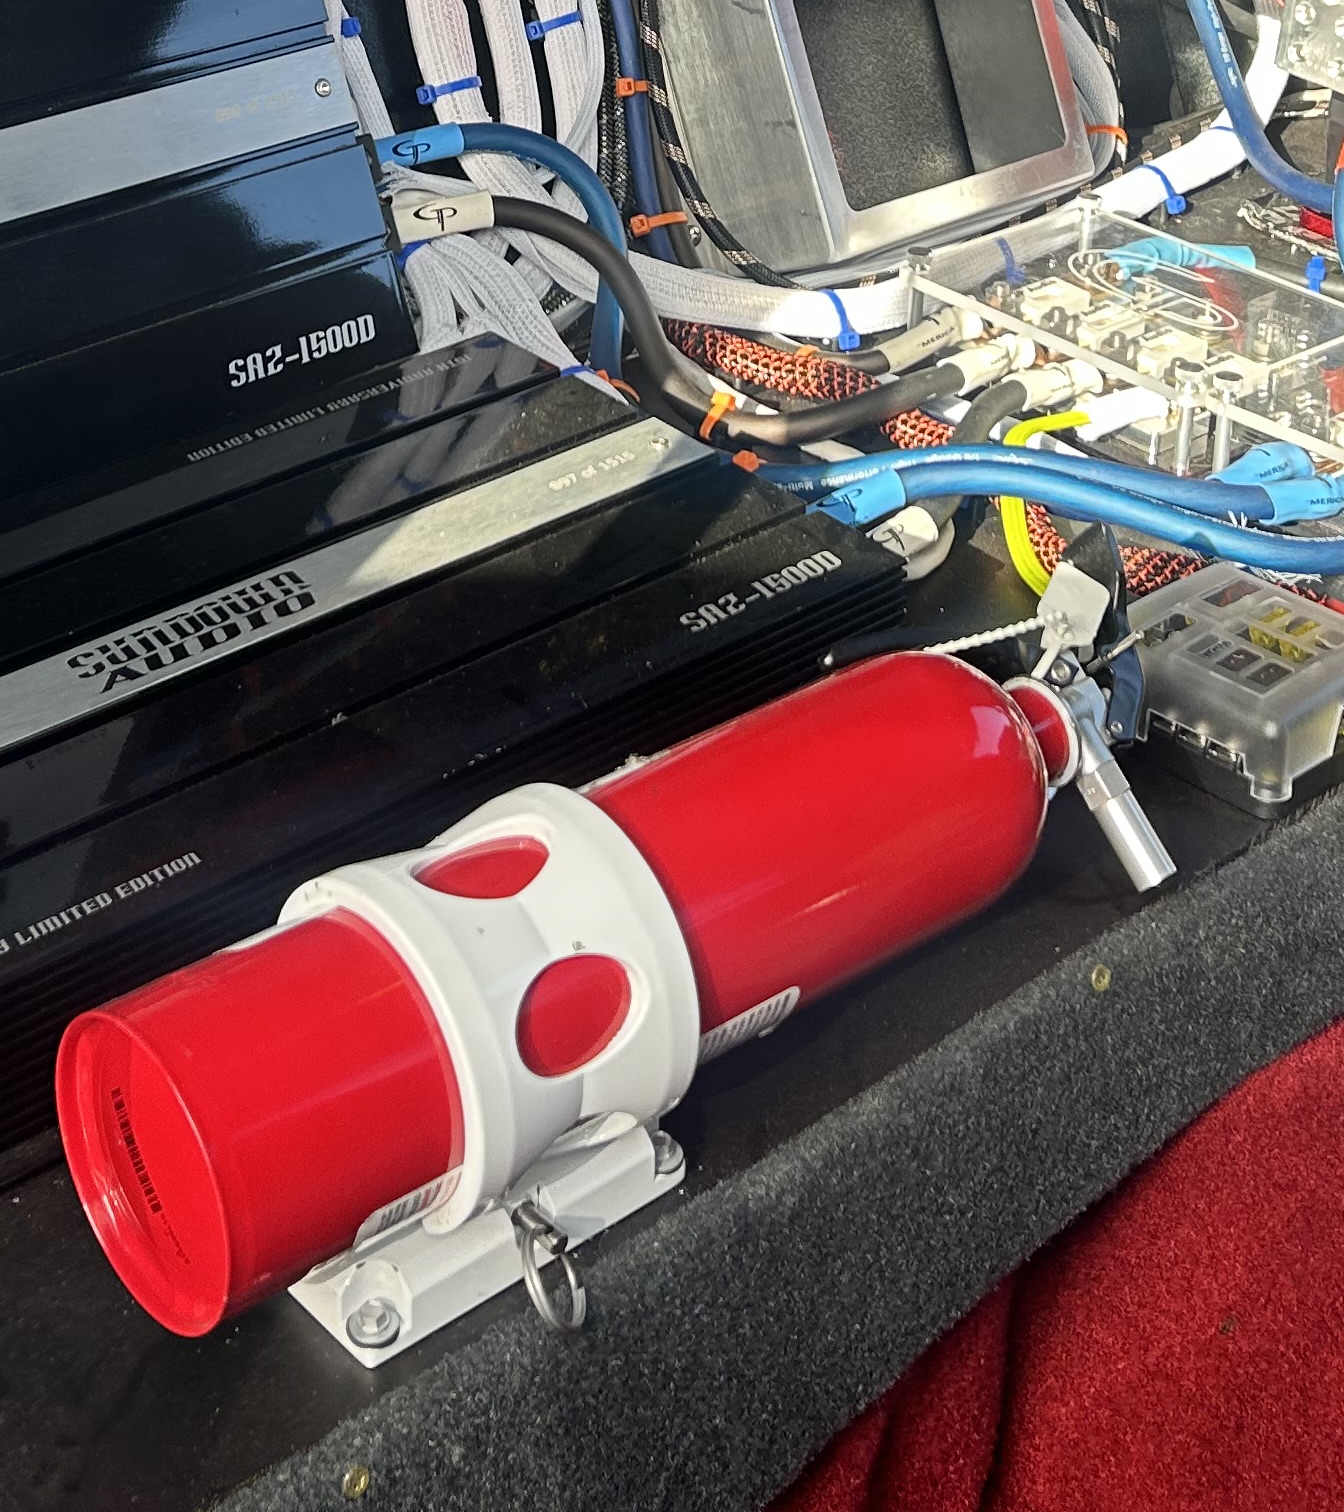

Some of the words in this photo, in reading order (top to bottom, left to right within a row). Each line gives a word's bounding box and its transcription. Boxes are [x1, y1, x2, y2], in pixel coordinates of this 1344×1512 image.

[255, 405, 326, 438] LIMITED
[326, 365, 435, 414] ANNIVERSARY
[186, 433, 254, 463] EDITION
[66, 570, 312, 679] SUNDOWN
[99, 591, 316, 694] AUDIO
[14, 891, 113, 947] LIMITED
[114, 850, 203, 900] EDITION
